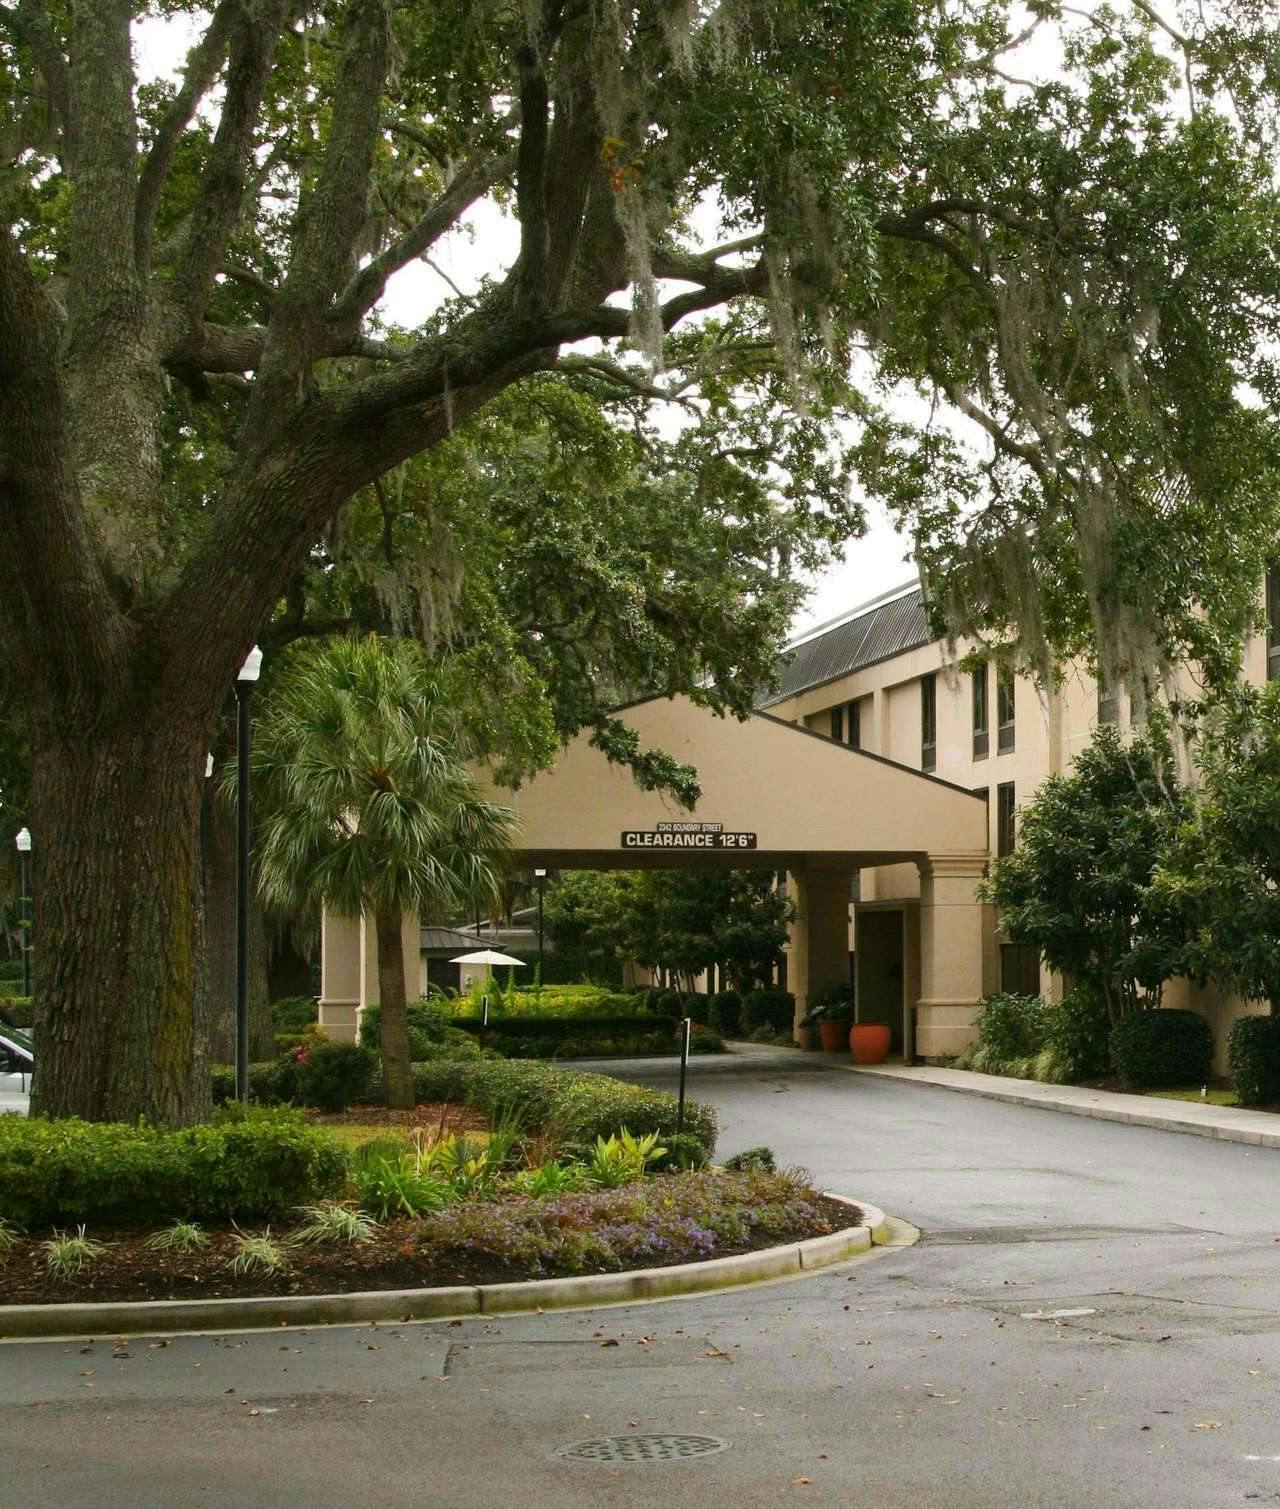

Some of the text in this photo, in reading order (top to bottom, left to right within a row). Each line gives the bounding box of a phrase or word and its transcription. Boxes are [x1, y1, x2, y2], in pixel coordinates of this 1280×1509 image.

[702, 823, 722, 832] STREET
[626, 833, 754, 847] CLEARANCE 12'6"
